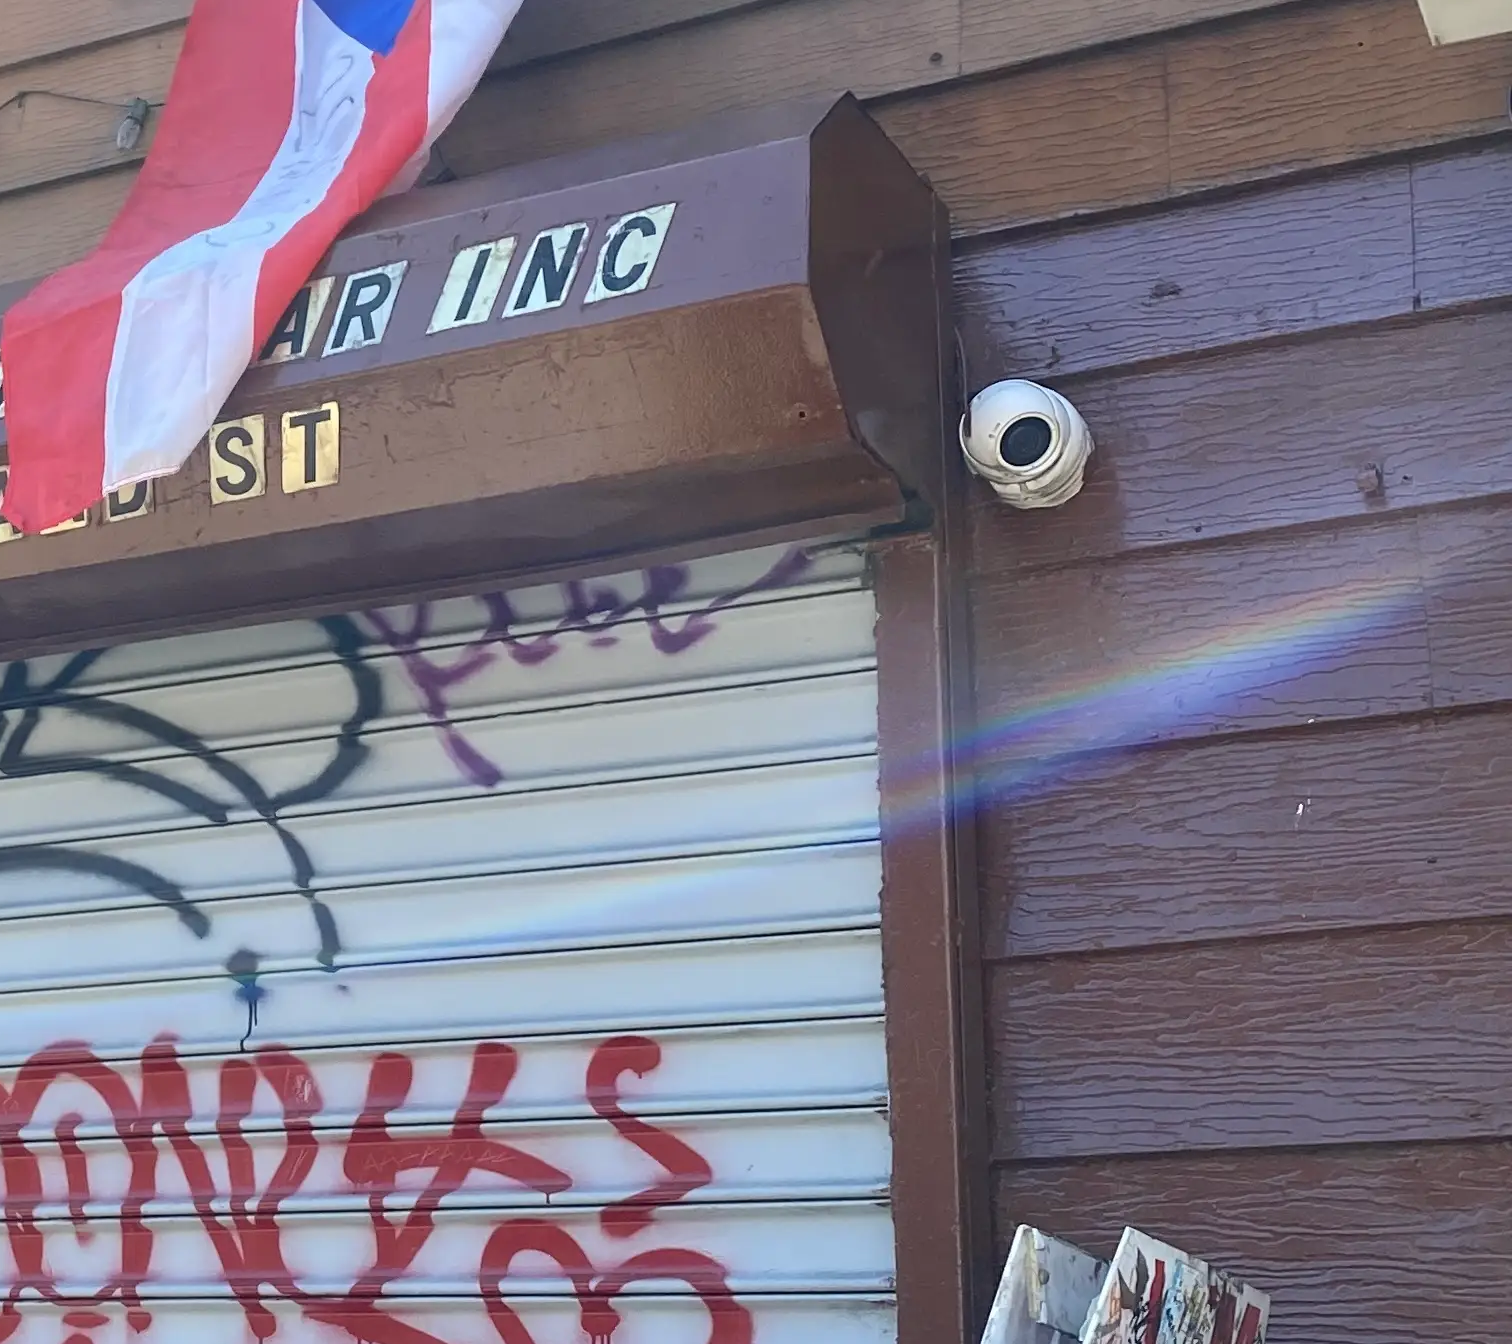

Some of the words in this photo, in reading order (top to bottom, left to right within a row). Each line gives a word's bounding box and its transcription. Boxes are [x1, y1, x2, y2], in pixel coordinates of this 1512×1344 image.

[260, 272, 392, 361] AR
[455, 215, 656, 322] INC
[215, 409, 331, 495] ST
